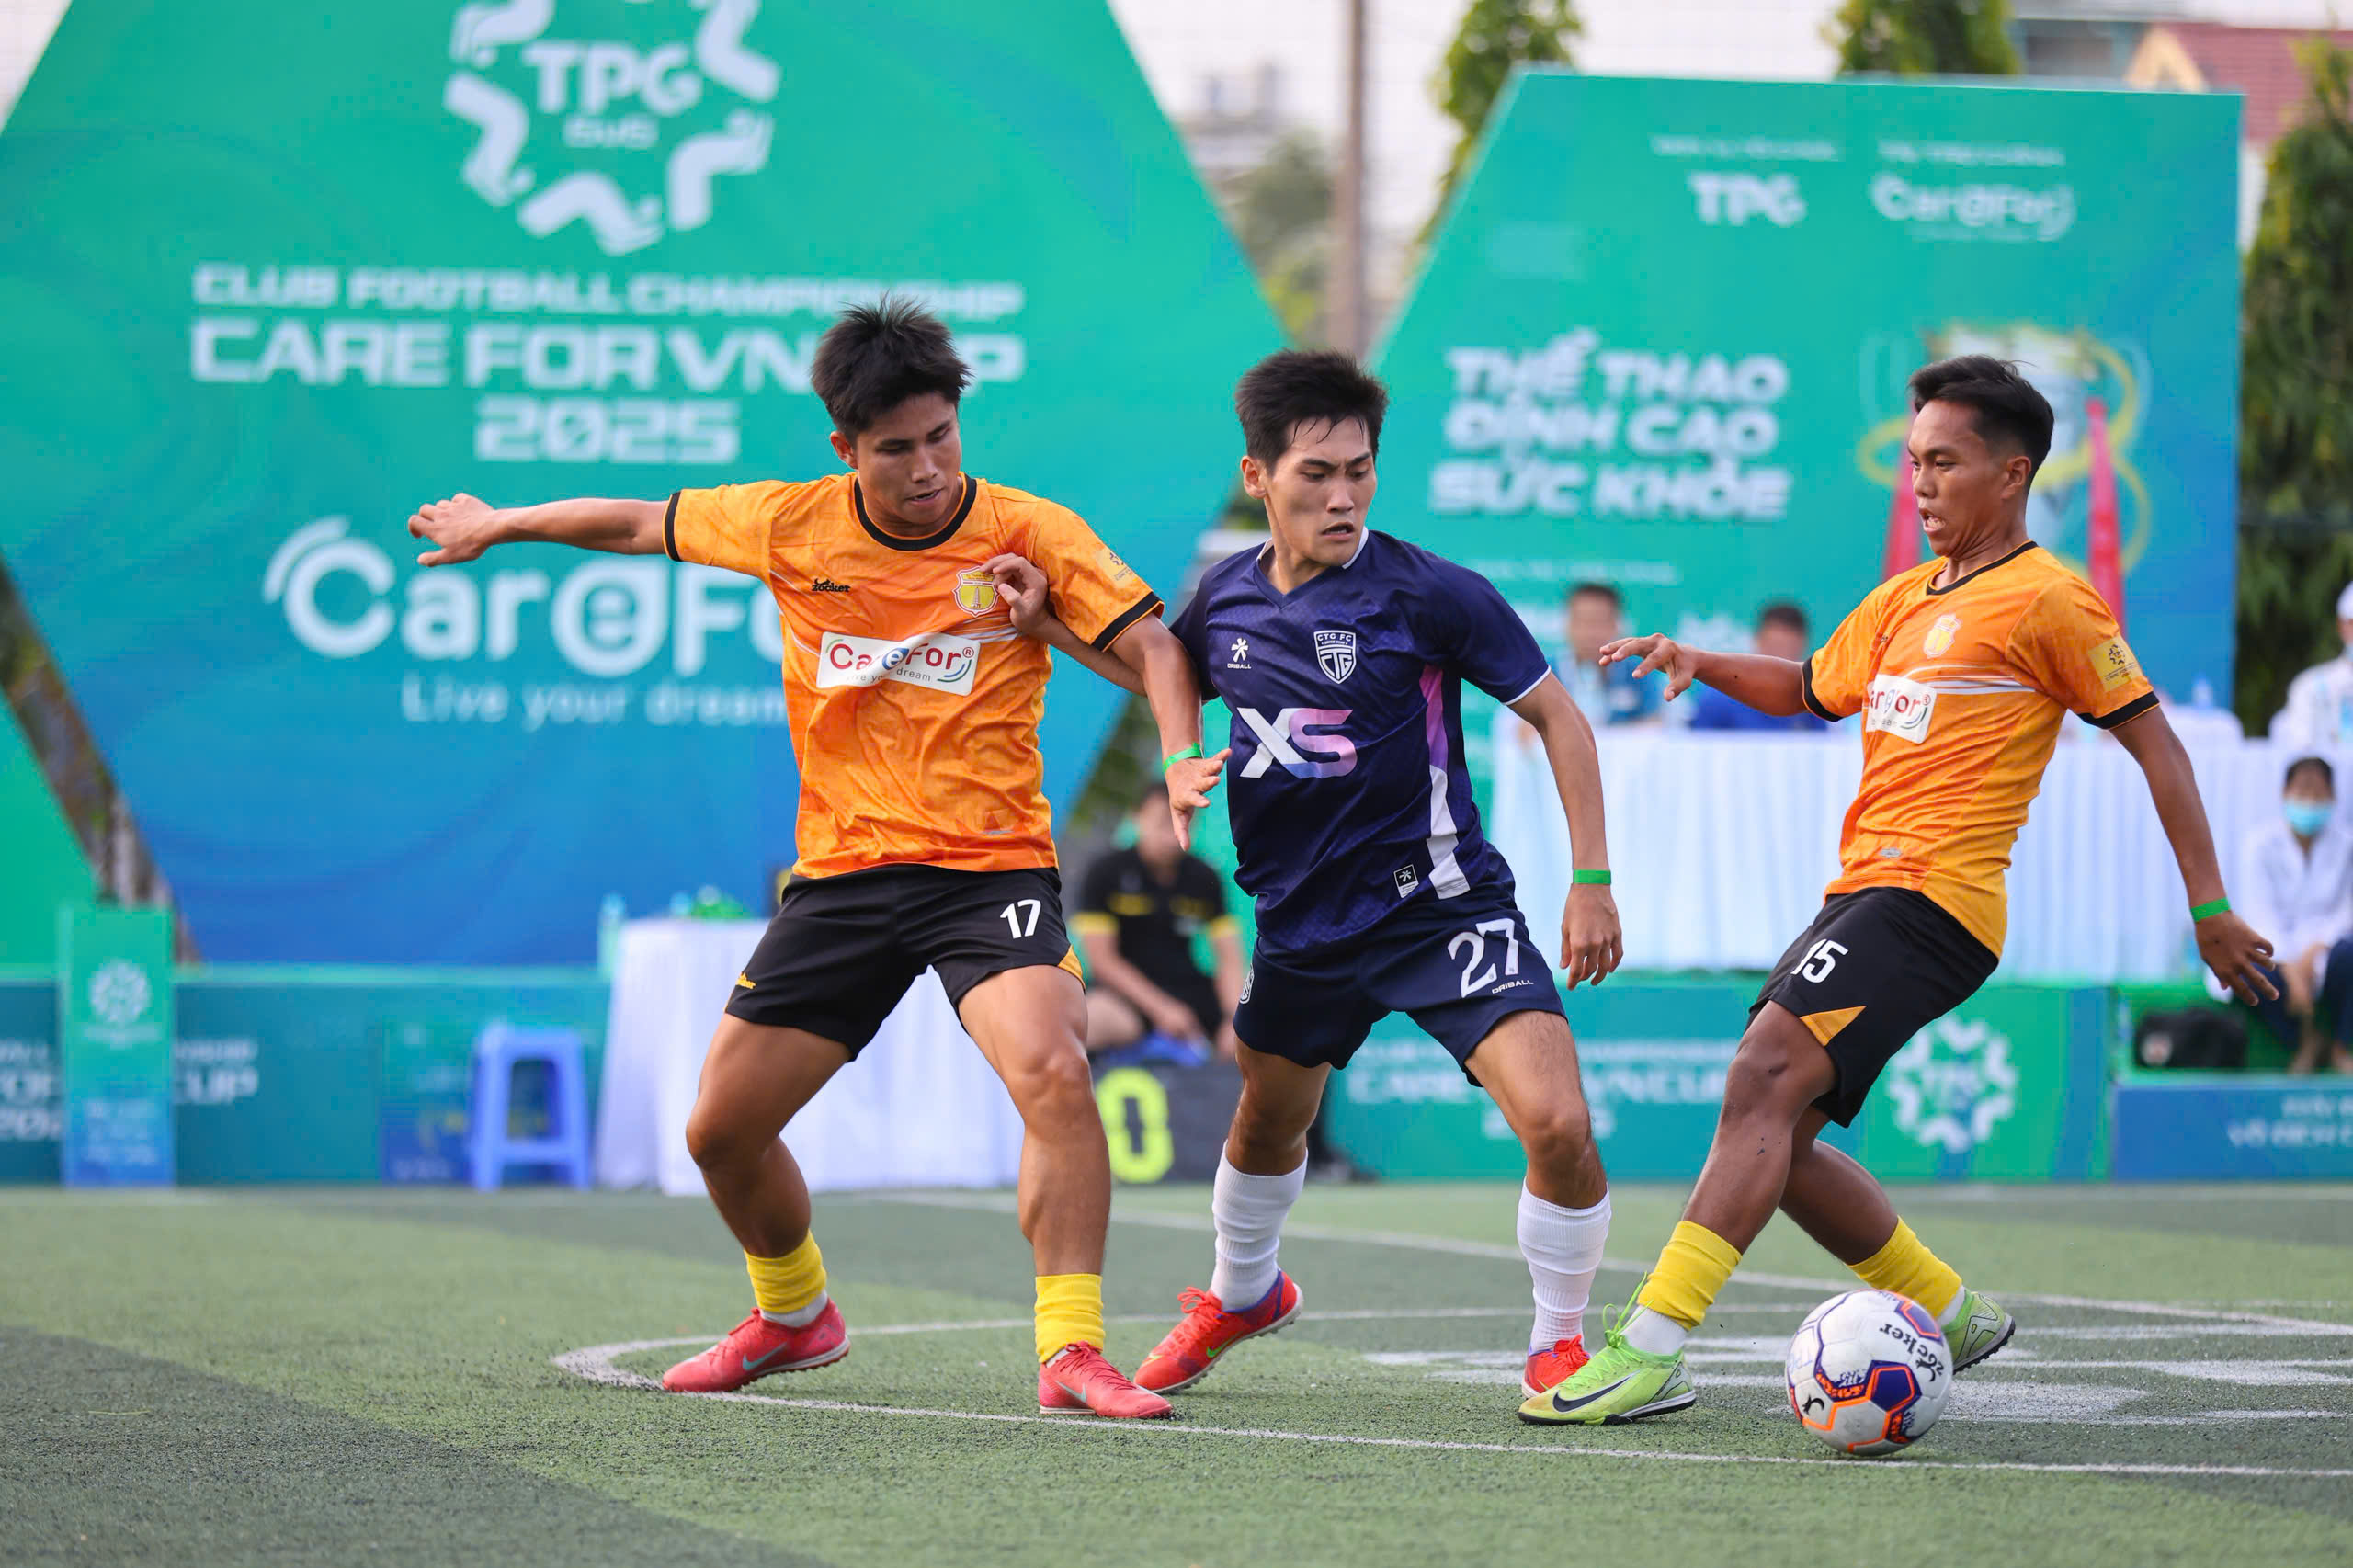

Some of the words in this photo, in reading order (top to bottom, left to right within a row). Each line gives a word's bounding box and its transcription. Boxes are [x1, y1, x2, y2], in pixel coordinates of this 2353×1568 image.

[521, 42, 704, 116] TPG
[1688, 172, 1806, 226] TPG
[193, 265, 337, 309] CLUB
[347, 268, 625, 315] FOOTBALL
[191, 318, 450, 386] CARE
[463, 324, 660, 392] FOR
[1597, 351, 1792, 404] THAO
[474, 395, 738, 463] 2025
[1624, 403, 1781, 457] CAO
[896, 668, 931, 682] dream
[401, 673, 510, 722] Live
[522, 682, 634, 733] your
[1236, 707, 1358, 779] XS
[999, 899, 1041, 939] 17
[1447, 917, 1519, 999] 27
[1790, 938, 1848, 983] 15
[1492, 979, 1534, 994] DRIBALL
[1096, 1066, 1174, 1184] 0
[1879, 1324, 1944, 1377] zocker
